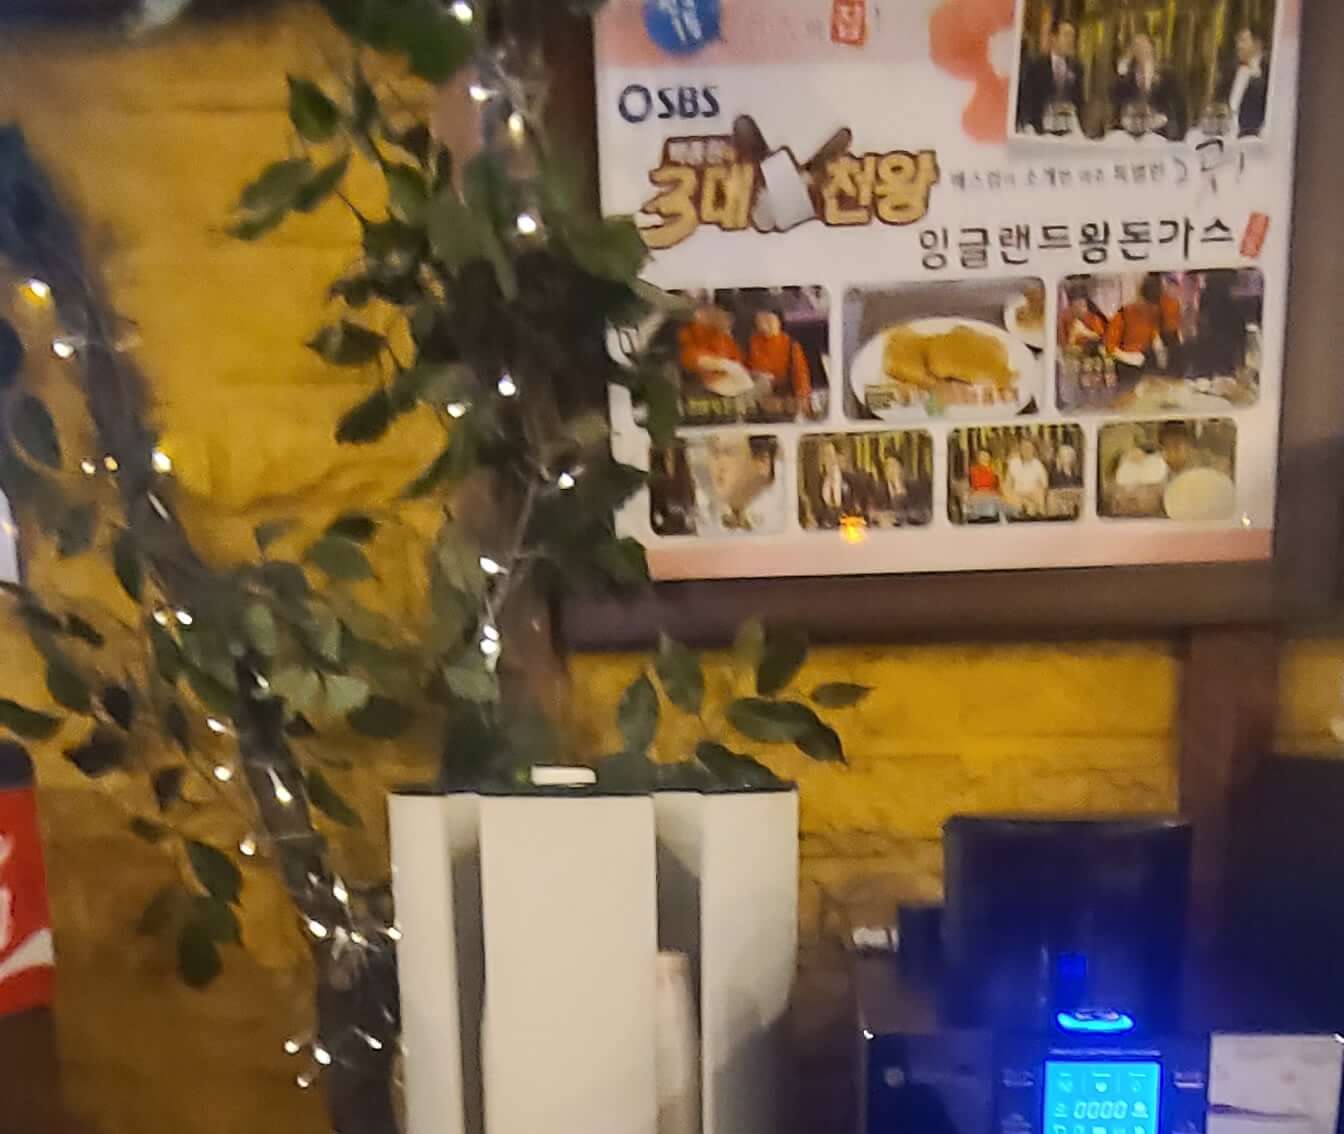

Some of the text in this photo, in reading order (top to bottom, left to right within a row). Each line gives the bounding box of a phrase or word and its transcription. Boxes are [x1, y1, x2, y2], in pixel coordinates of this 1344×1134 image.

[656, 85, 721, 119] SBS
[634, 150, 940, 250] 3대 천왕
[919, 216, 1234, 270] 잉글랜드왕돈가스
[1073, 1101, 1129, 1120] 0000
